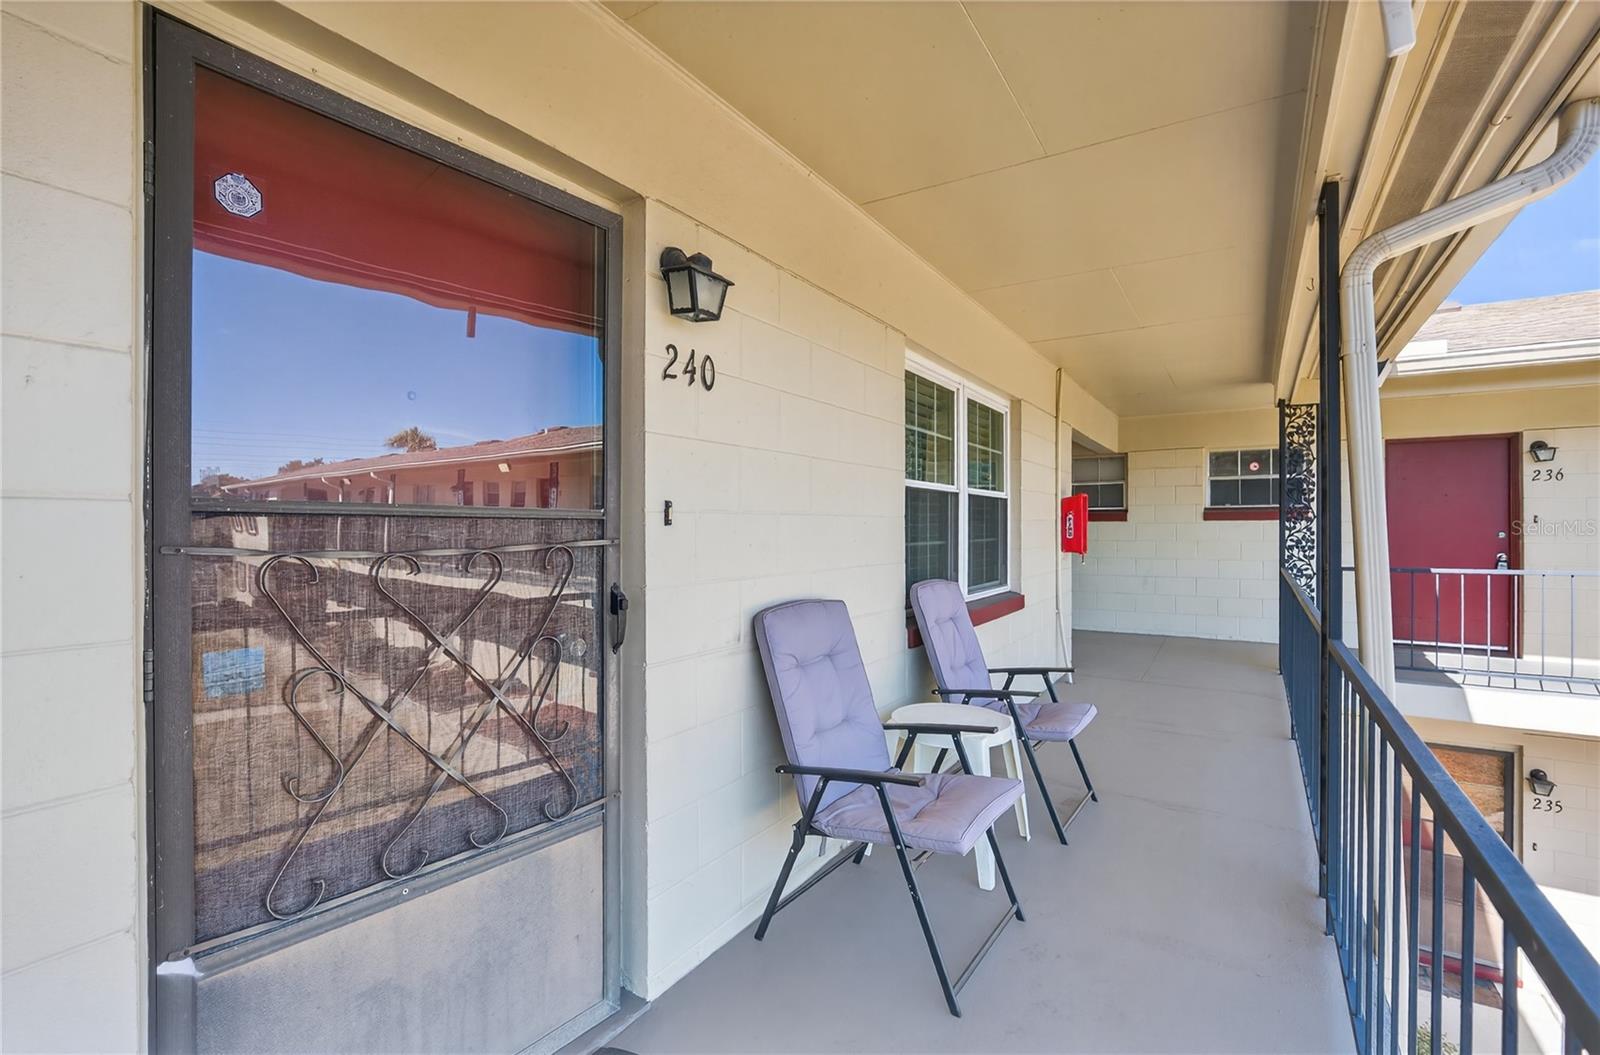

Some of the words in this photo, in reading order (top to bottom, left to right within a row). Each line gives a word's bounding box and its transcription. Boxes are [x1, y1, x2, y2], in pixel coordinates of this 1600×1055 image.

[662, 343, 715, 391] 240
[1531, 467, 1564, 482] 236
[1532, 797, 1563, 814] 235
